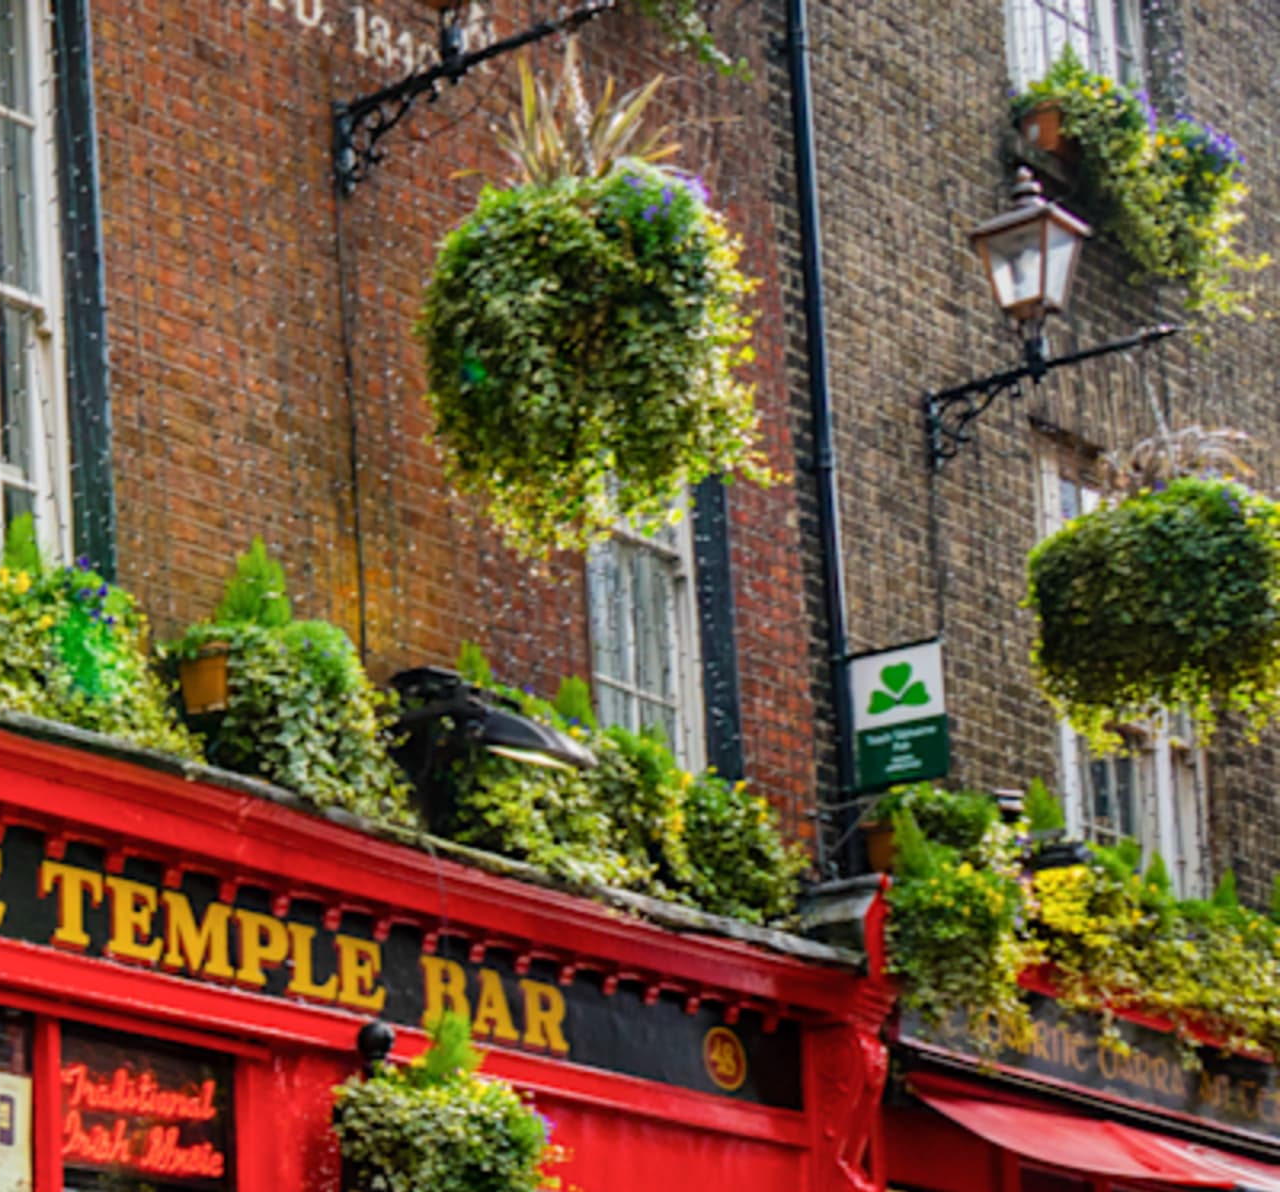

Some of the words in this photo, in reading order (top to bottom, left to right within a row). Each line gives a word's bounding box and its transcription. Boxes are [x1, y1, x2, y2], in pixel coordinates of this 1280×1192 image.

[40, 861, 388, 1014] TEMPLE
[420, 955, 571, 1057] BAR
[60, 1061, 218, 1120] Traditional
[60, 1109, 131, 1164] Irish
[140, 1125, 225, 1178] Music
